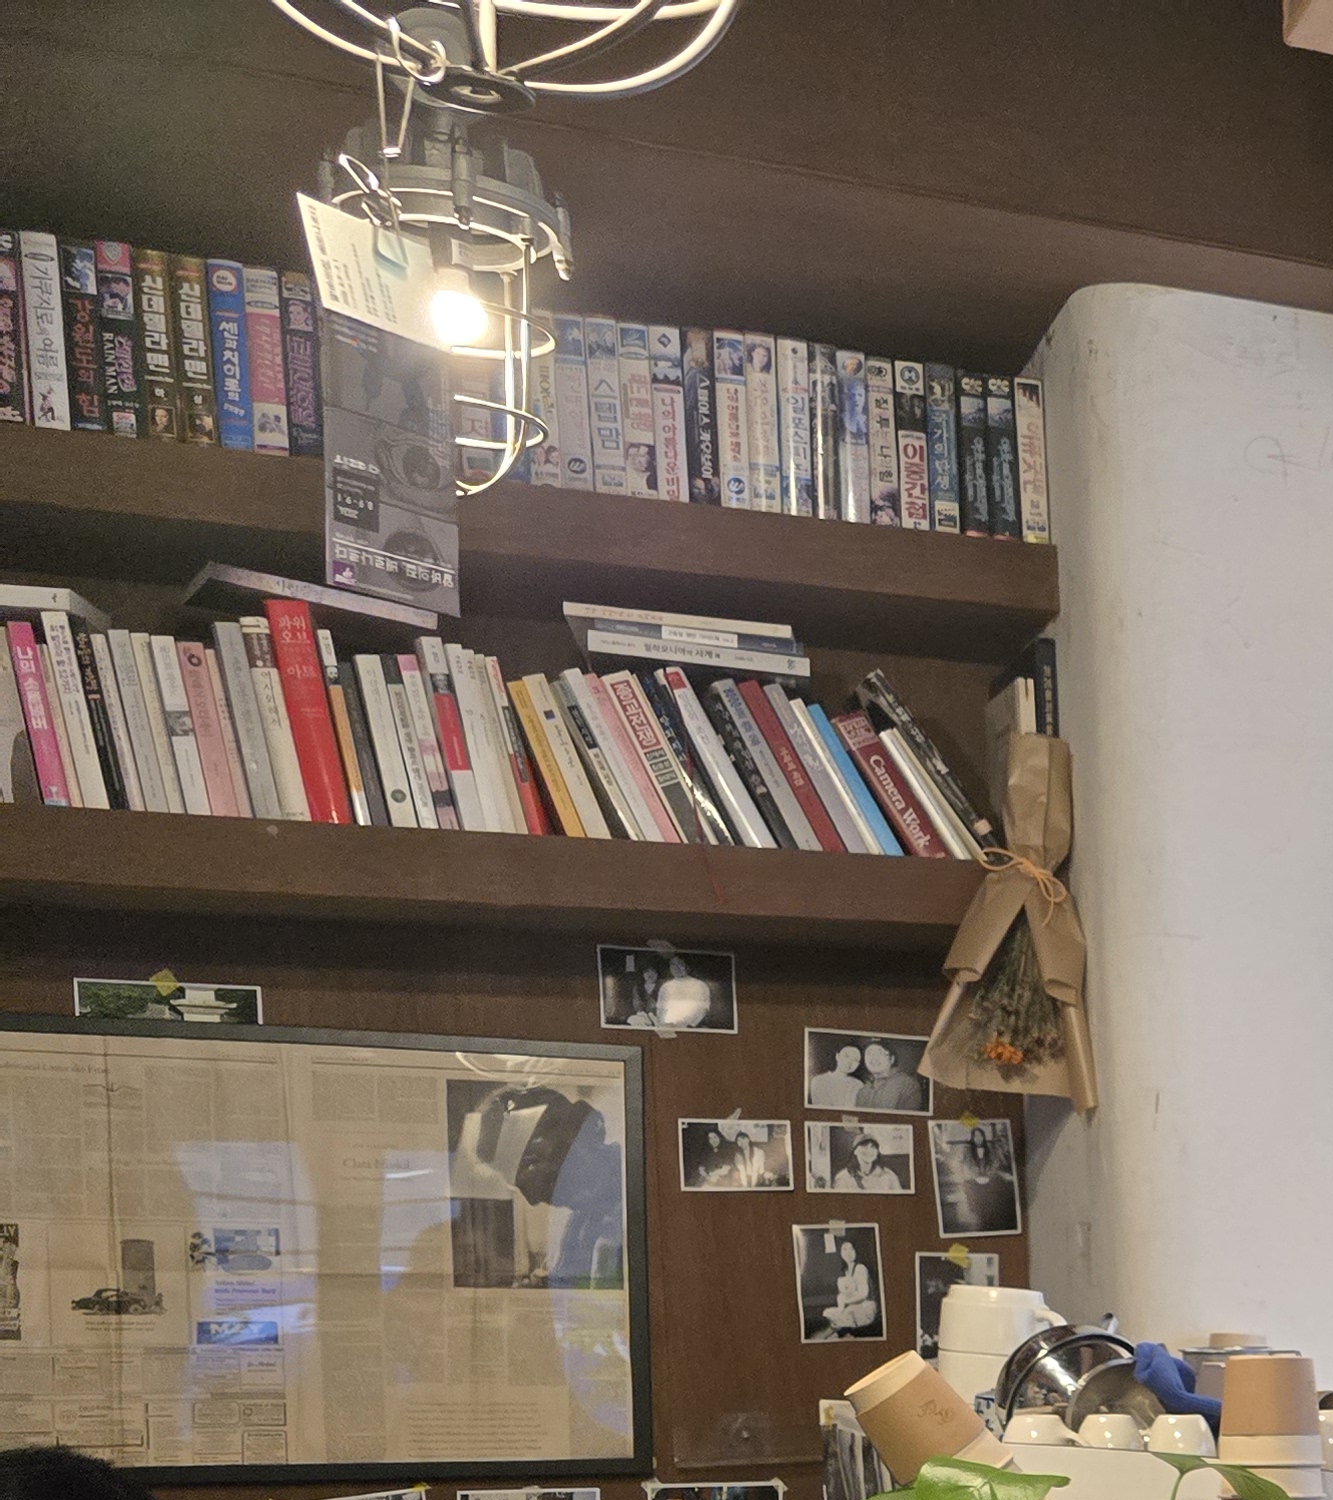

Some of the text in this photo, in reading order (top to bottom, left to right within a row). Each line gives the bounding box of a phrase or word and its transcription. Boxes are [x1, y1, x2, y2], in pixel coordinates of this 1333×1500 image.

[102, 331, 118, 395] RAIN MAN
[900, 442, 928, 521] 이중간첩
[278, 613, 306, 628] 파워
[282, 631, 309, 643] 오브
[868, 754, 932, 850] Camera Work
